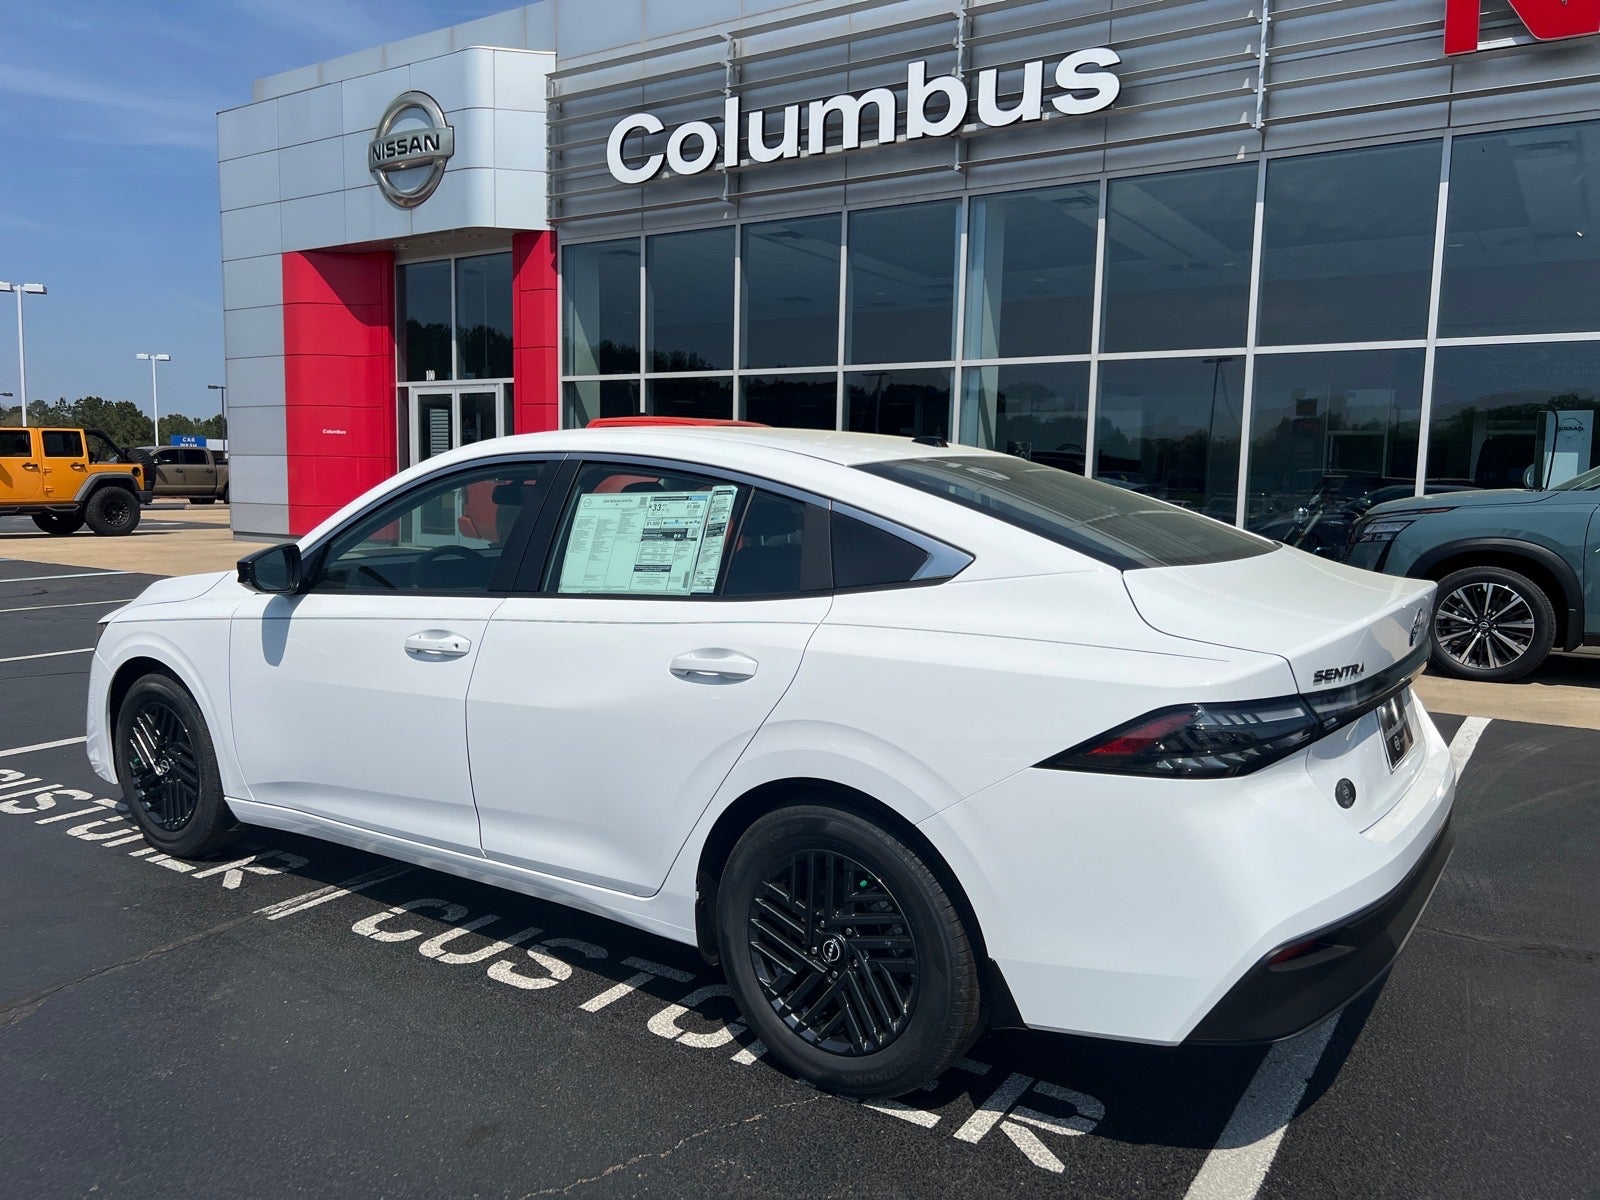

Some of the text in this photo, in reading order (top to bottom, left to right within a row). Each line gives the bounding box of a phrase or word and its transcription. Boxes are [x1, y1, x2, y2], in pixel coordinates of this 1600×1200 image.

[606, 47, 1122, 185] Columbus
[371, 133, 440, 163] NISSAN
[426, 369, 436, 381] 100
[651, 503, 662, 512] 33
[1313, 661, 1365, 683] SENTRA
[351, 898, 1106, 1174] CUSTOR
